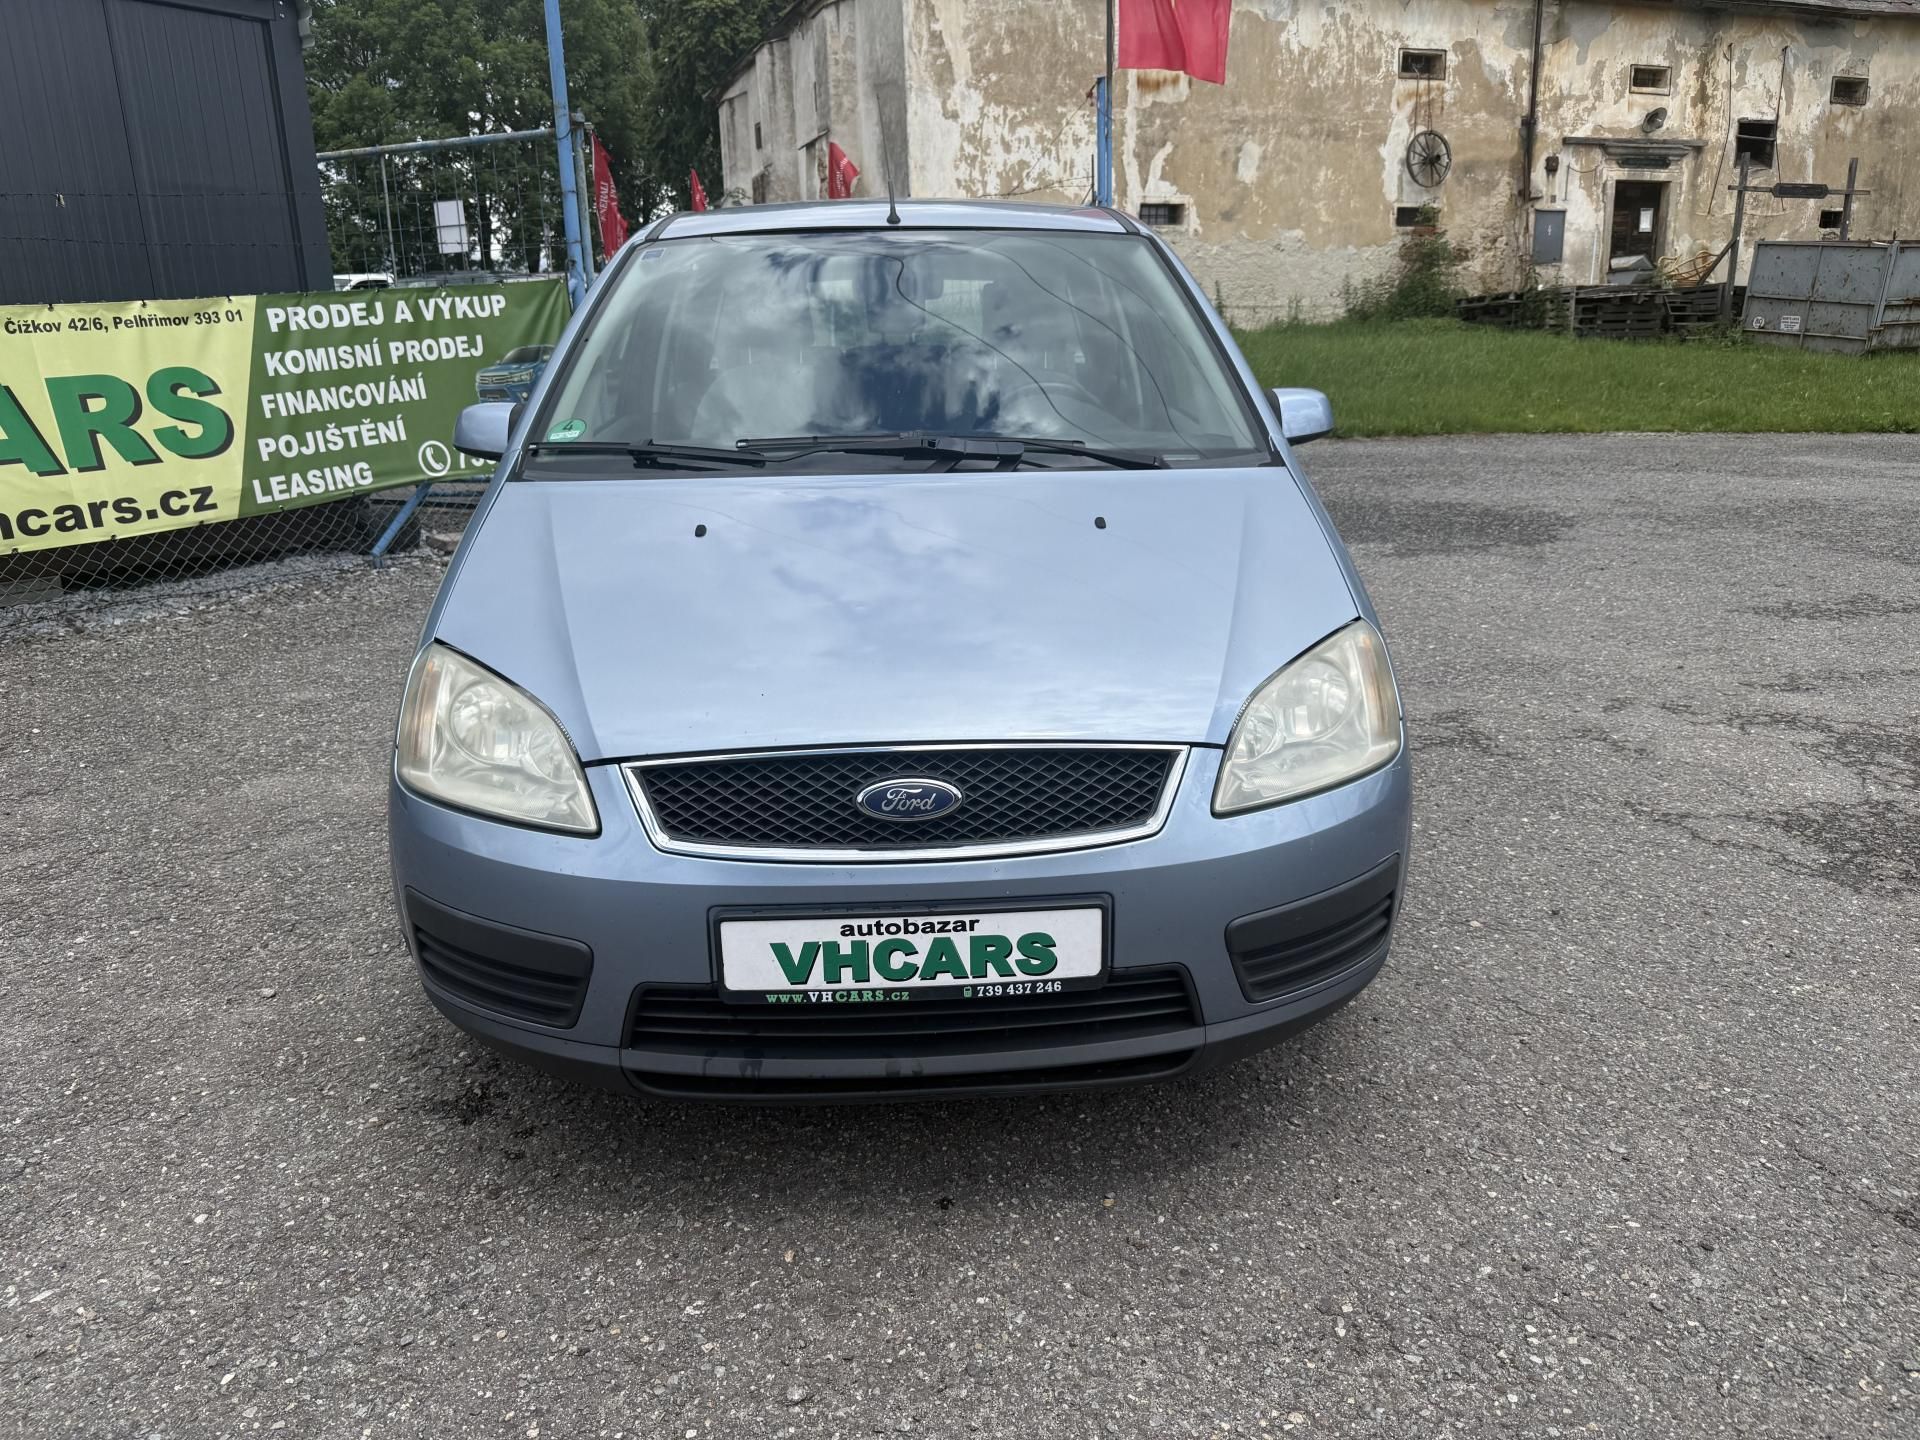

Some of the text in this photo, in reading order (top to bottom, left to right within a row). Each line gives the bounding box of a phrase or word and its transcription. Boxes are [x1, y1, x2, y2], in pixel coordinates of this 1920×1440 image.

[4, 309, 244, 335] Čížkov 42/6, Pelhřimov 393 01
[266, 291, 506, 333] PRODEJ A VÝKUP
[263, 334, 484, 377] KOMISNÍ PRODEJ
[261, 372, 427, 418] FINANCOVÁNÍ
[257, 414, 407, 462] POJIŠTĚNÍ
[562, 420, 574, 431] 4
[252, 461, 373, 504] LEASING
[881, 788, 937, 811] Ford
[839, 918, 980, 937] autobazar
[769, 932, 1058, 985] VHCARS
[766, 990, 910, 1003] www.VHCARS.cz
[977, 981, 1062, 997] 739 437 246
